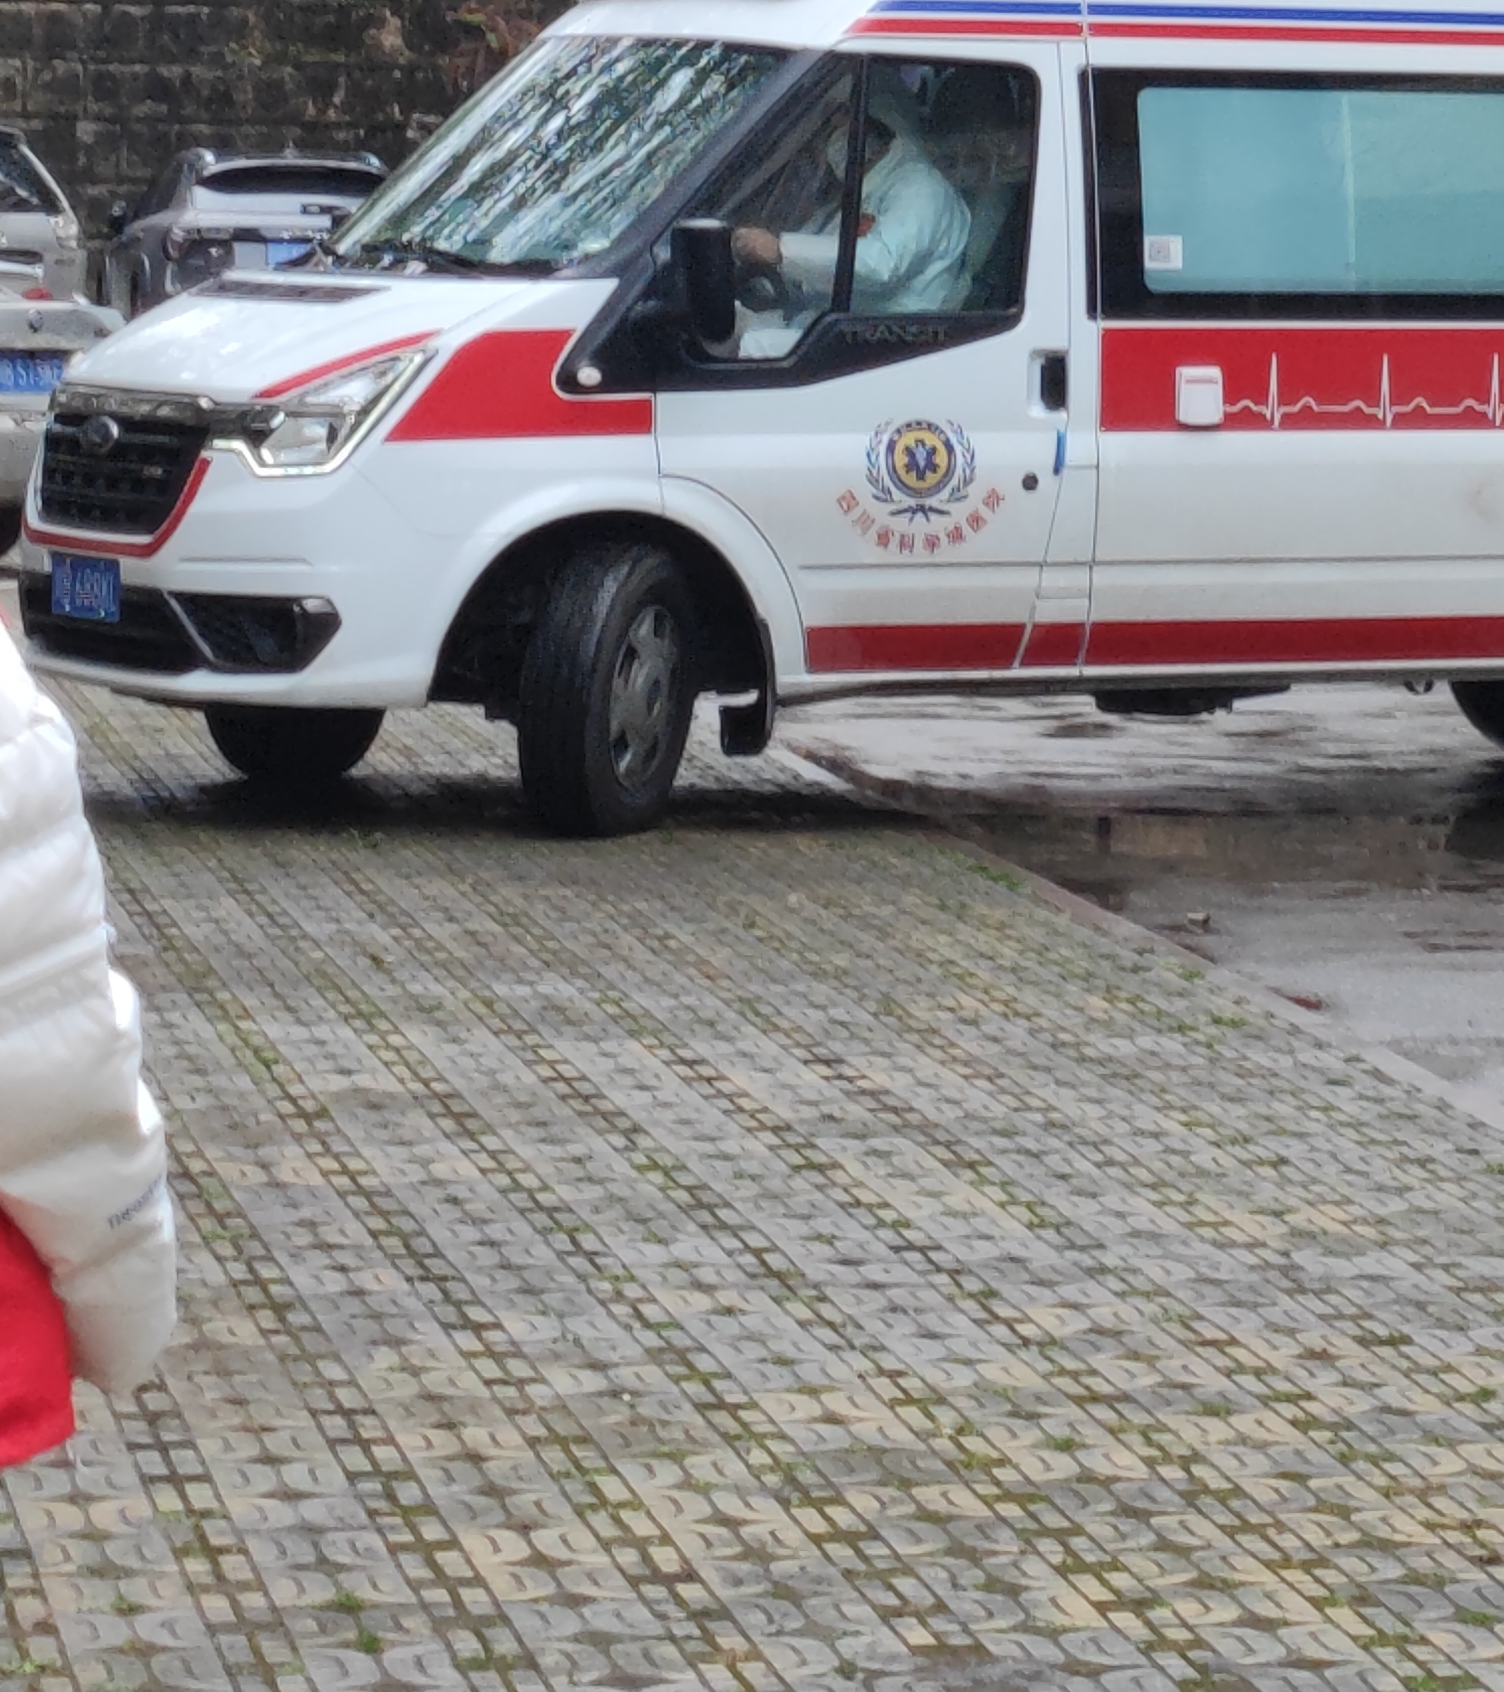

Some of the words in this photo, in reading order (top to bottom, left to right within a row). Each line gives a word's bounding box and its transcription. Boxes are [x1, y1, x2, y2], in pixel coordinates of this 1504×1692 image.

[836, 487, 1006, 556] 四川省科学城医院
